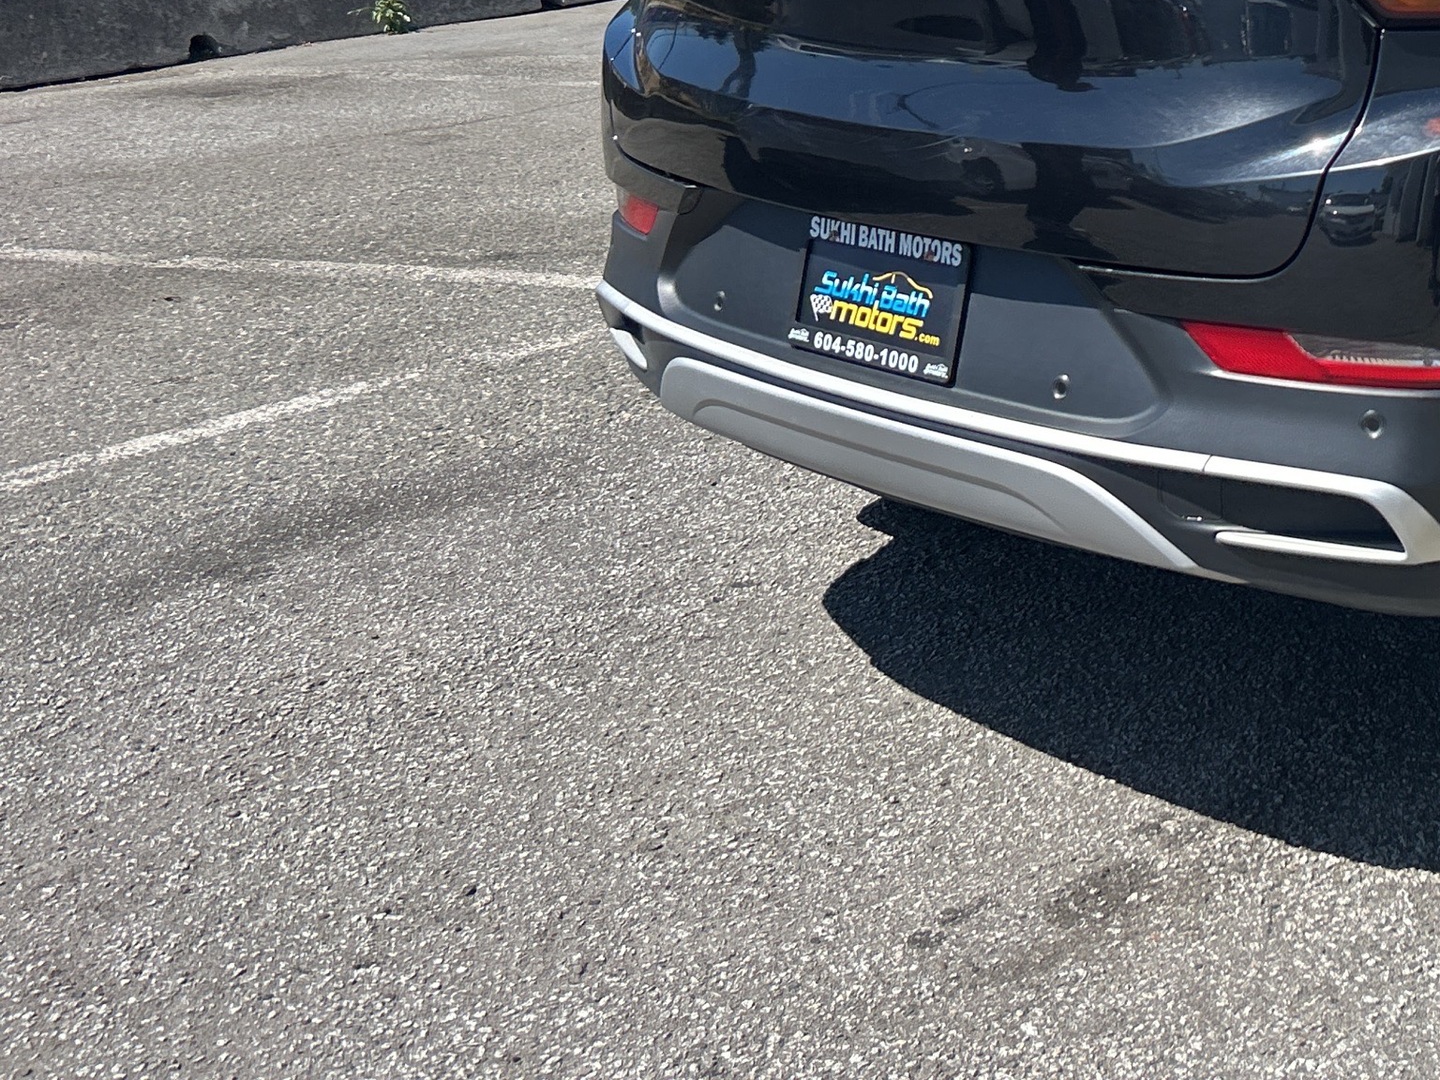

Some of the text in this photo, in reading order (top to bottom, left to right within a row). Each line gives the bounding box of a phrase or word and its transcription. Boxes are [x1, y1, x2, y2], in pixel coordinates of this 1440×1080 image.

[809, 215, 963, 267] SUKHI BATH MOTORS
[814, 270, 931, 318] Sukhi Bath
[813, 331, 919, 373] 604-580-1000
